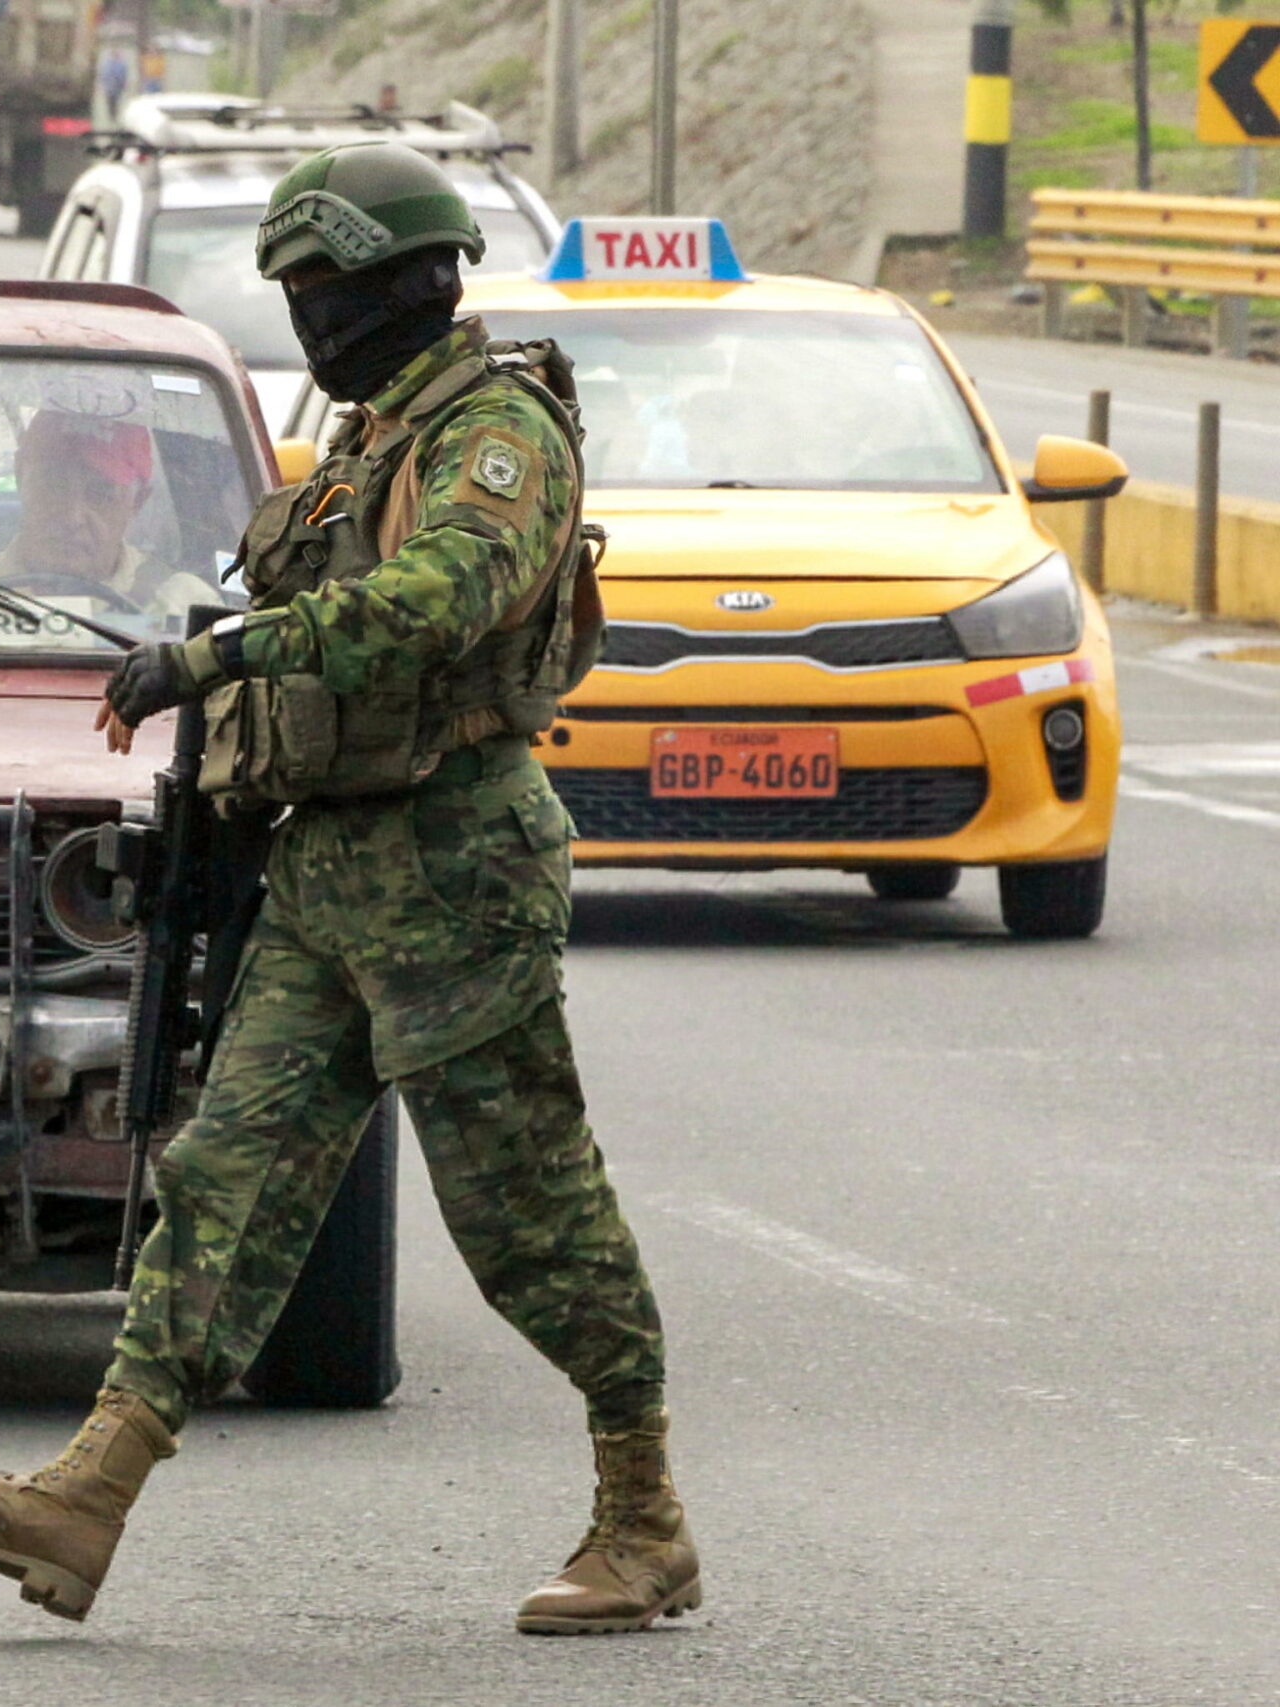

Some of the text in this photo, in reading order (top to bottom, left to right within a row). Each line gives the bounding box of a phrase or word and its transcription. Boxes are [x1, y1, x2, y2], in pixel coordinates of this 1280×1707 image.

[595, 231, 698, 269] TAXI
[723, 590, 765, 608] KIA
[710, 732, 779, 746] ECUADOR
[658, 753, 831, 789] GBP-4060
